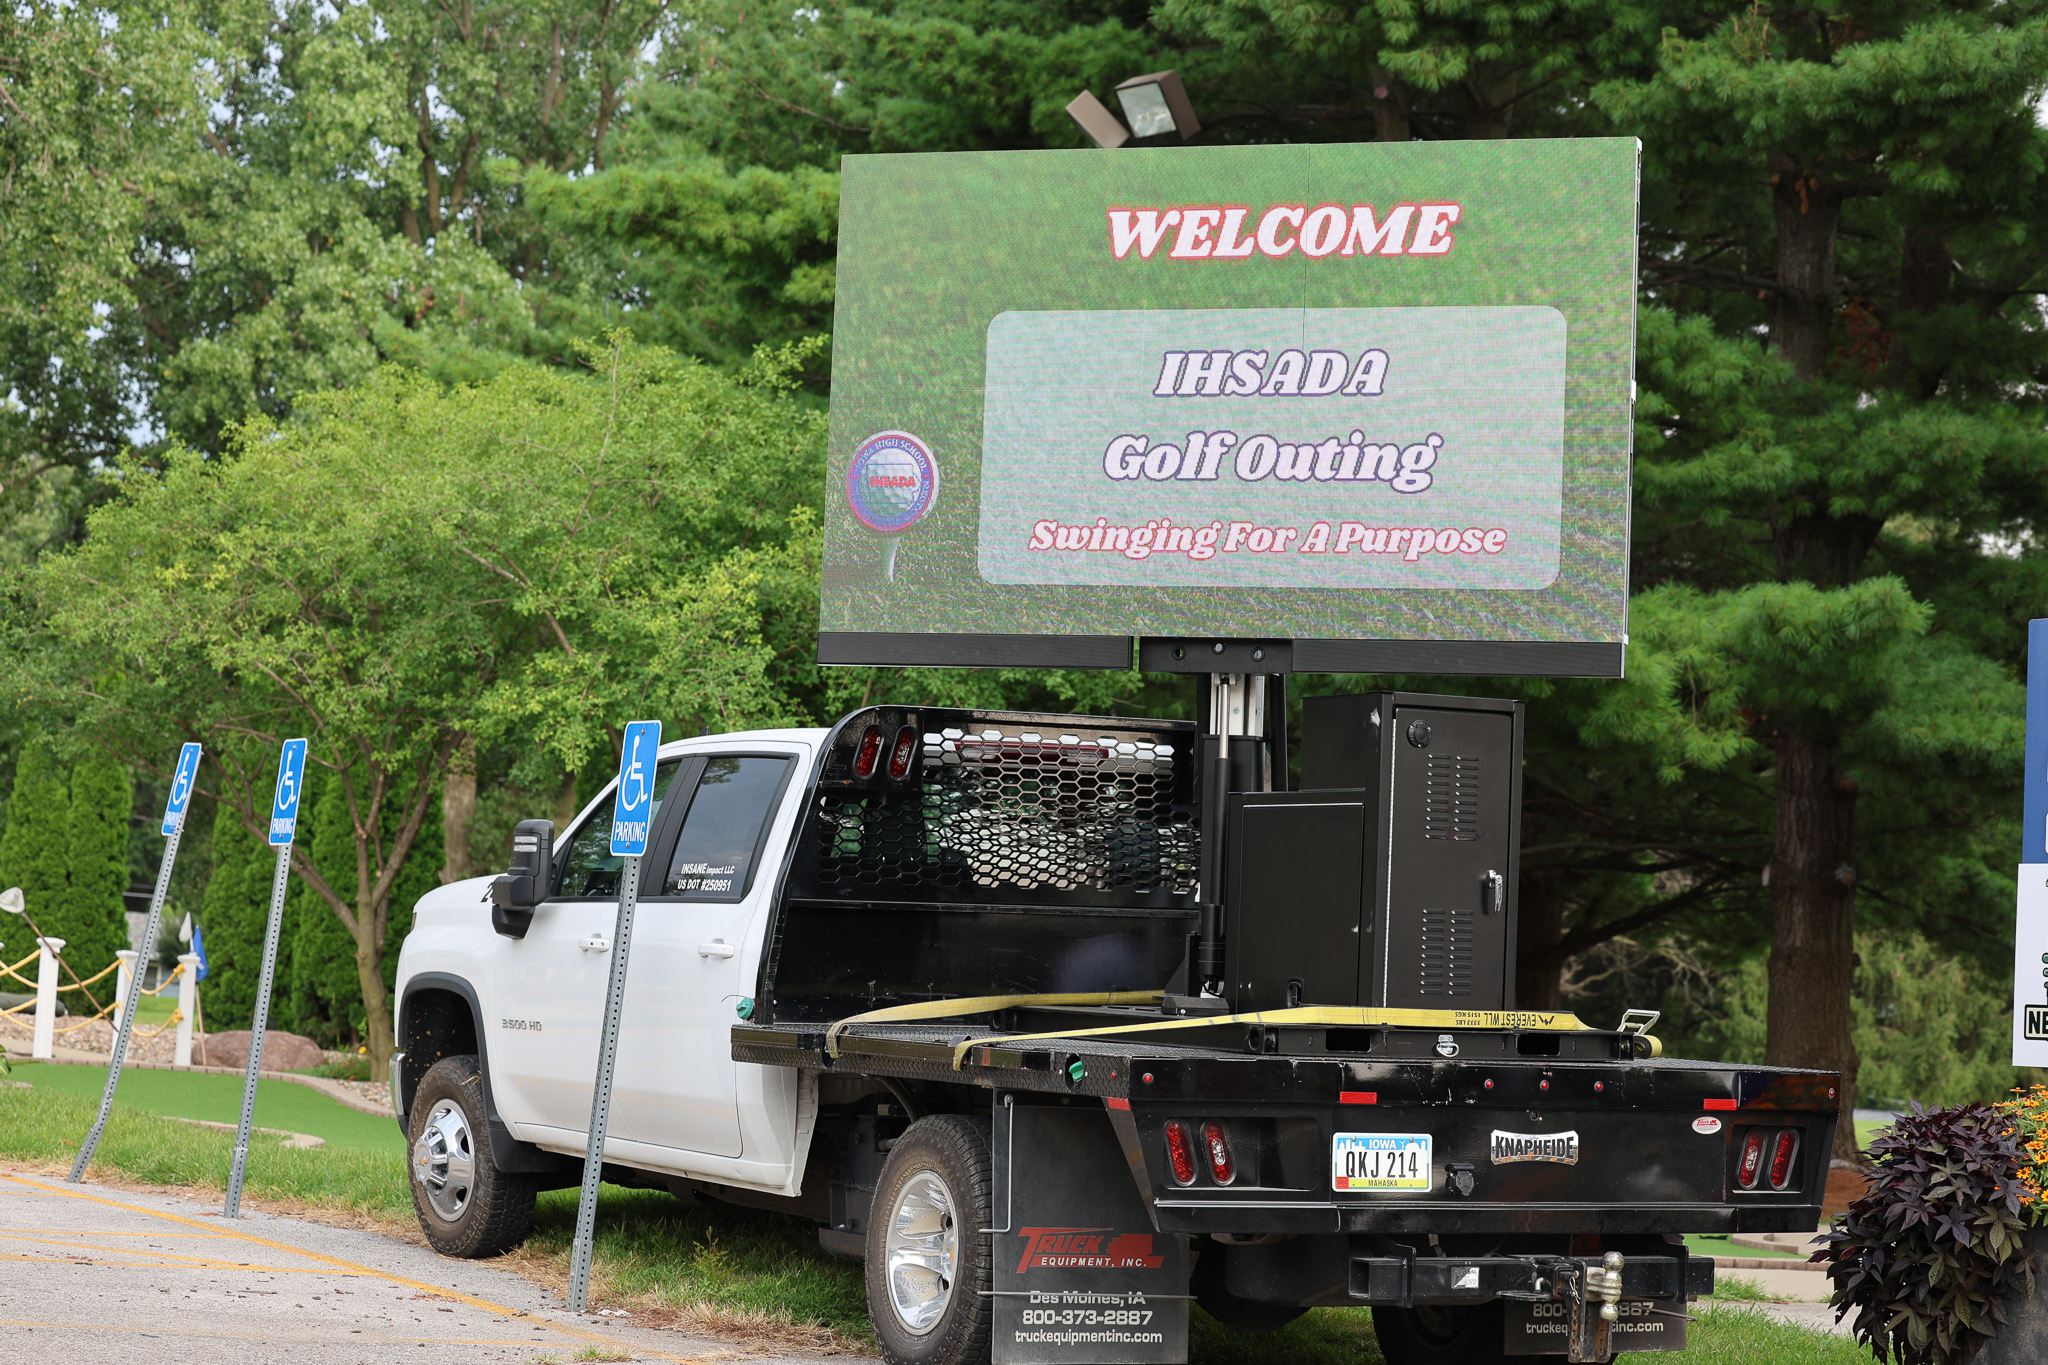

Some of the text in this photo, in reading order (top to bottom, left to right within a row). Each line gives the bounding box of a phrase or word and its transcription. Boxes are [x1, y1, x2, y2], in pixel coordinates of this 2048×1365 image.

[1107, 202, 1461, 259] WELCOME
[1153, 349, 1389, 396] IHSADA
[900, 441, 927, 470] SCHOOL
[1103, 429, 1444, 494] Golf Outing
[1028, 517, 1508, 561] Swinging For A Purpose
[272, 817, 294, 834] PARKING
[614, 821, 646, 842] PARKING
[681, 863, 735, 876] INSANE impact LLC
[677, 880, 732, 891] US DOT #250951
[502, 1019, 542, 1031] 3500 HD
[1484, 1013, 1536, 1026] EVEREST WLL
[1369, 1139, 1397, 1150] IOWA
[1495, 1136, 1574, 1159] KNAPHEIDE
[1346, 1151, 1418, 1178] QKJ 214
[1368, 1179, 1398, 1187] MAHASKA
[1016, 1227, 1110, 1273] TRUCK
[1041, 1257, 1147, 1268] EQUIPMENT, INC.
[1030, 1290, 1146, 1307] Des Moines, IA
[1022, 1310, 1153, 1326] 800-373-2887
[1015, 1329, 1163, 1346] truckequipmentinc.com
